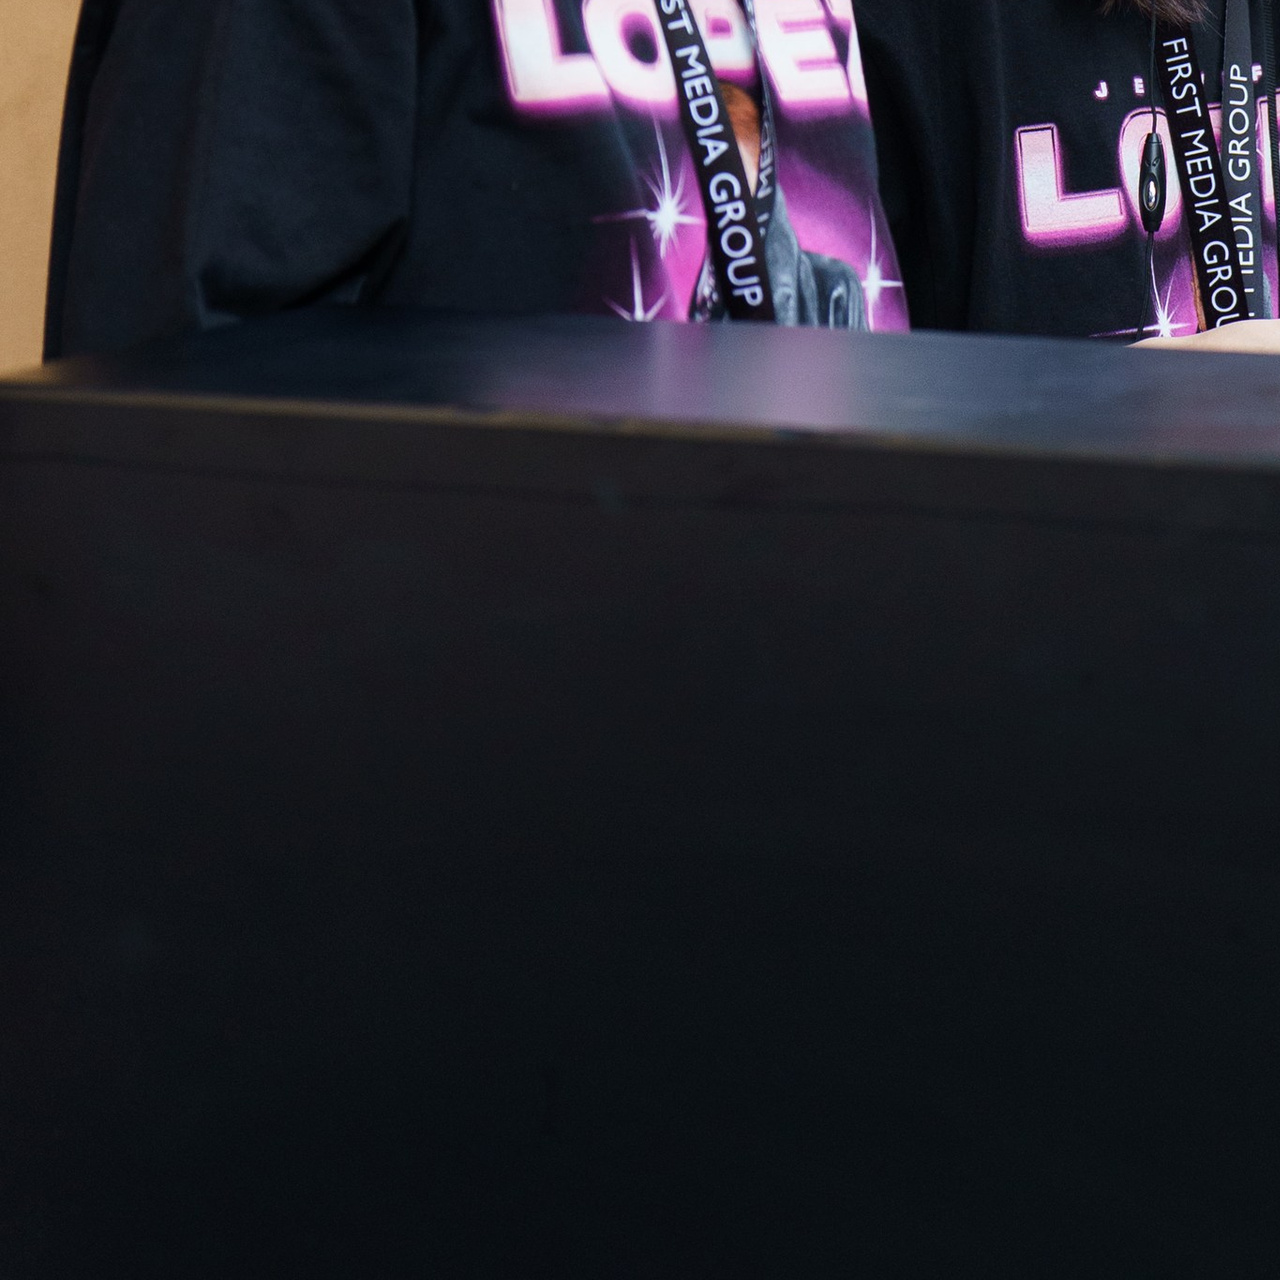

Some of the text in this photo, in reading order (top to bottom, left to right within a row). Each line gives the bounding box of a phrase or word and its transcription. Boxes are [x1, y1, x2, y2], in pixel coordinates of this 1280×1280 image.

[1162, 37, 1202, 118] FIRST
[1227, 63, 1252, 182] GROUP
[675, 43, 730, 166] MEDIA
[709, 171, 765, 307] GROUP
[1180, 128, 1223, 233] MEDIA
